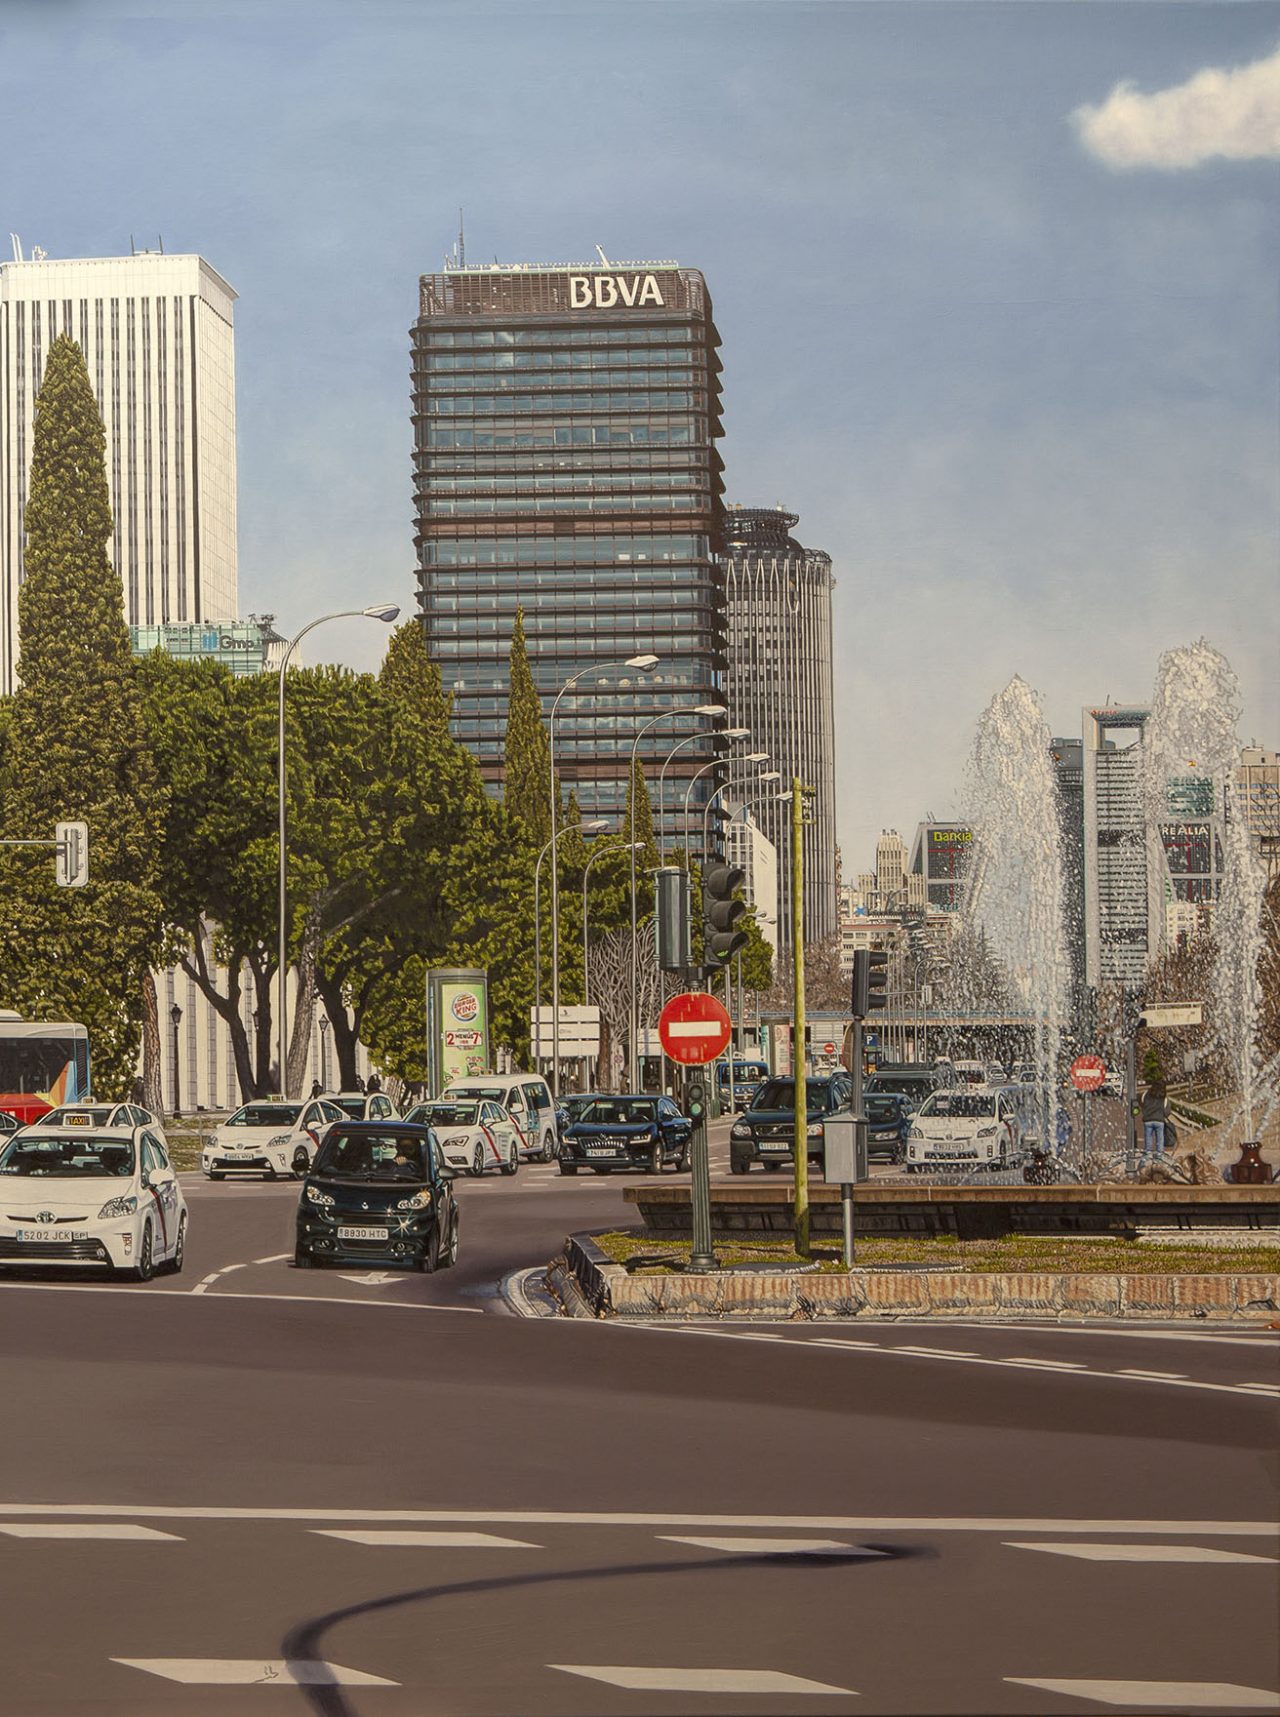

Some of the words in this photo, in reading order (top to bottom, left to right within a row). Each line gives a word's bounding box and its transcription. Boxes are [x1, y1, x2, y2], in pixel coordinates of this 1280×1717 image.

[570, 275, 665, 309] BBVA
[220, 635, 255, 650] Gmp
[1162, 826, 1209, 836] REALIA
[454, 998, 476, 1009] BURGER
[455, 1003, 477, 1016] KING
[447, 1032, 454, 1045] 2
[866, 1035, 873, 1045] P
[70, 1117, 85, 1125] TAXI
[24, 1231, 49, 1240] 5202
[52, 1232, 70, 1240] JCK
[344, 1229, 367, 1238] 8930
[368, 1230, 387, 1239] HTC
